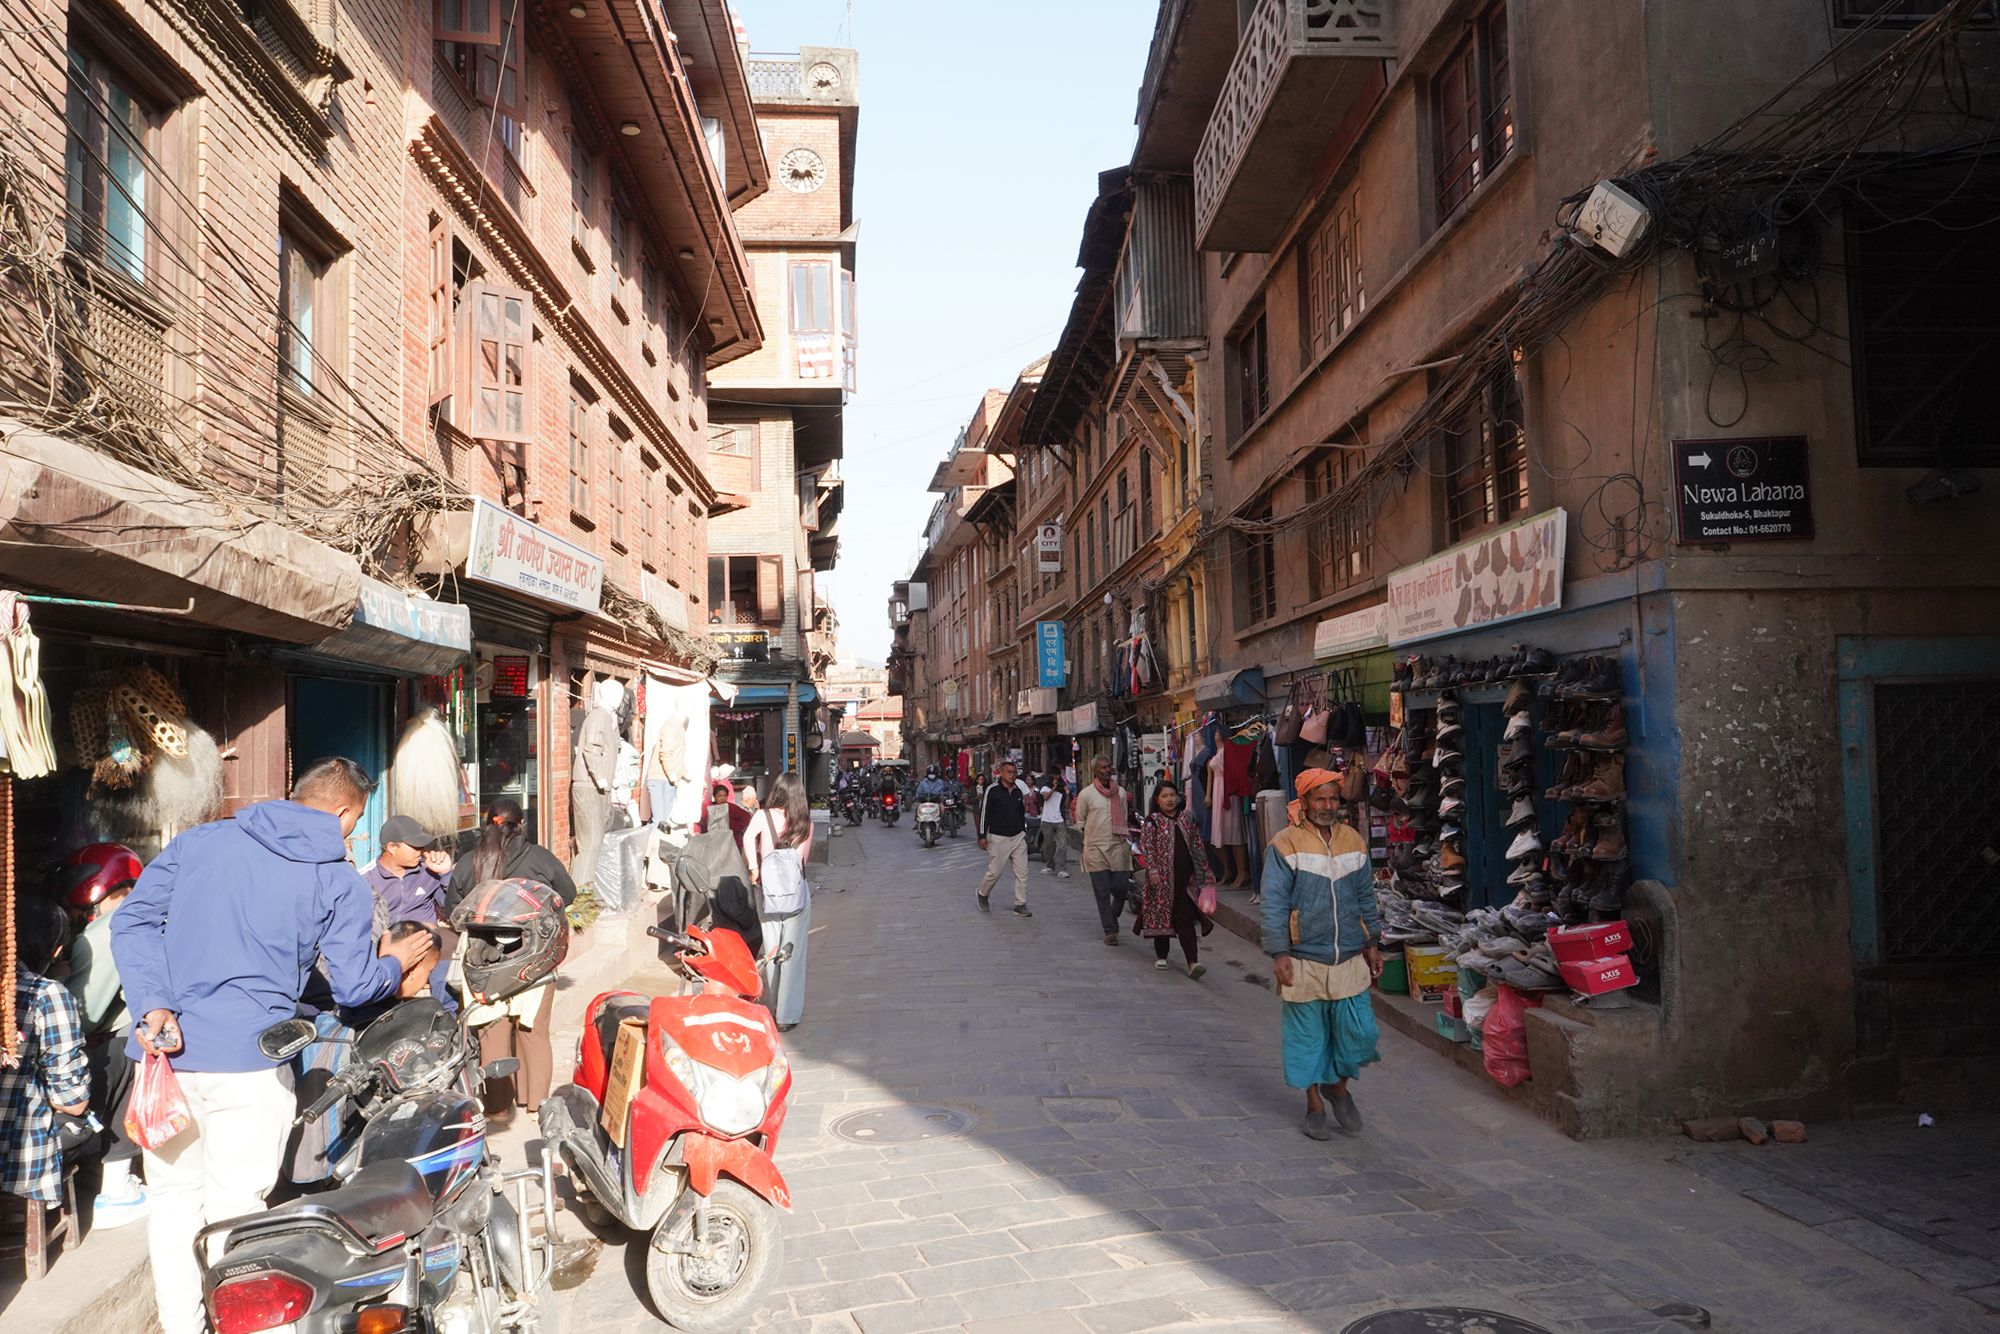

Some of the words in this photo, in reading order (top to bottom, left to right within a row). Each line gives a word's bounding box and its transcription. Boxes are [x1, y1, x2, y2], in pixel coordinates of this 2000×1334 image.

[1684, 484, 1737, 504] Newa
[1741, 482, 1805, 502] Lahana
[1700, 510, 1752, 521] Sukuldhoka-5,
[1753, 509, 1791, 519] Bhaktapur
[1702, 526, 1732, 536] Contact
[497, 517, 515, 558] श्री
[517, 528, 546, 573] गणेश
[1604, 933, 1621, 943] AXIS
[1601, 969, 1620, 980] AXIS
